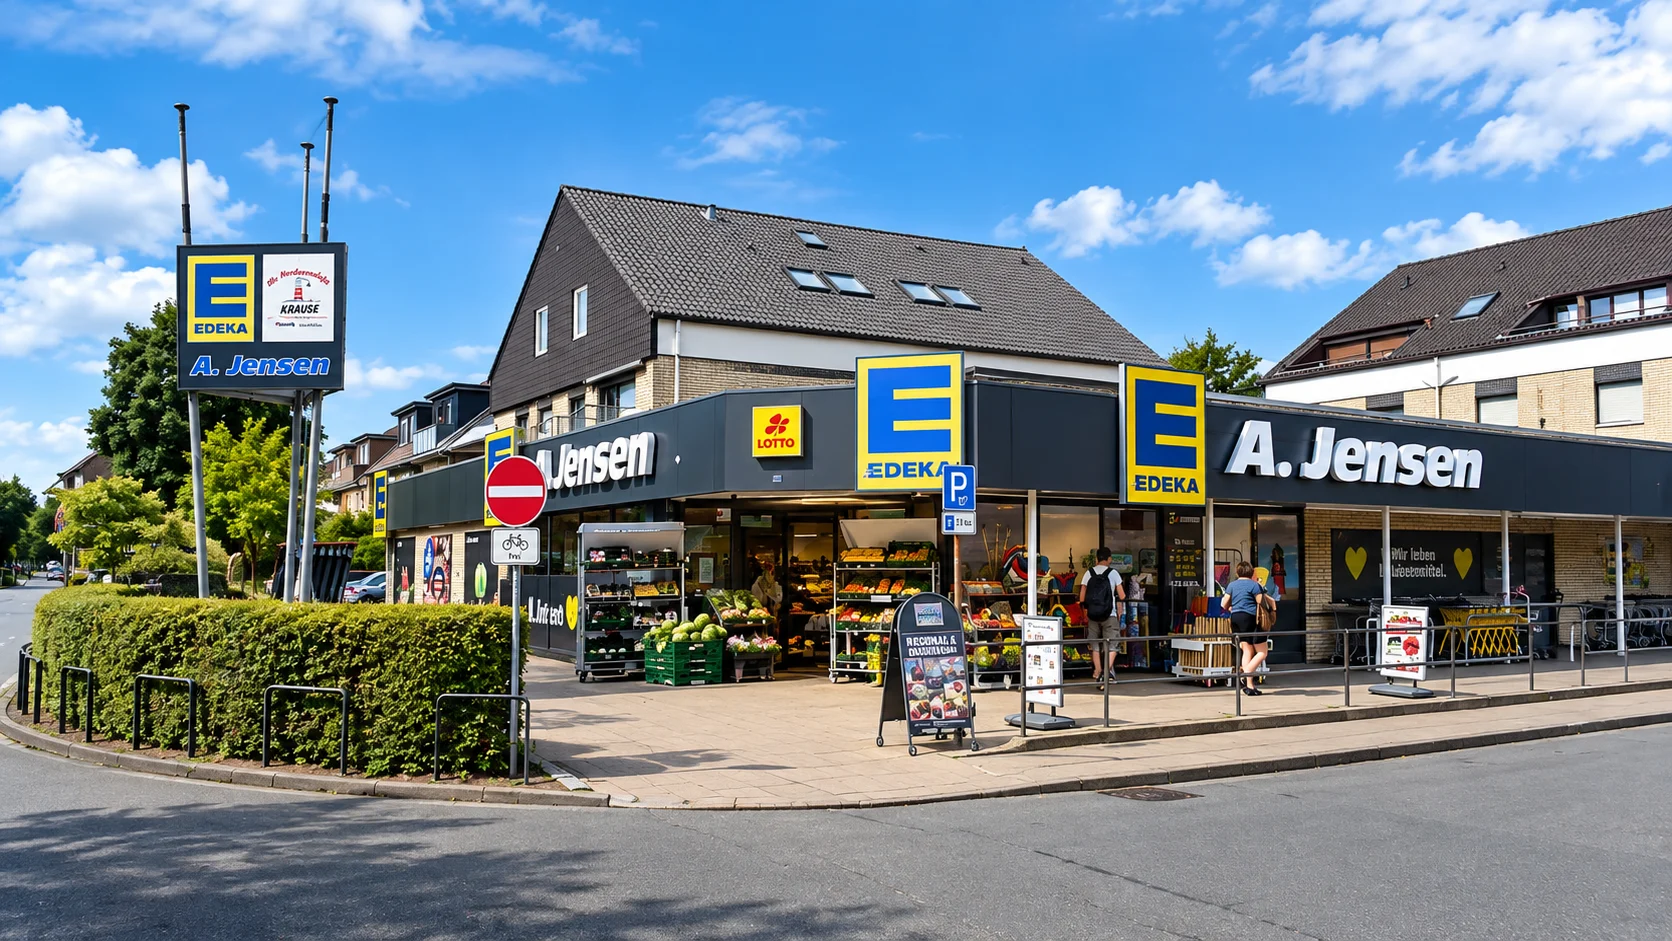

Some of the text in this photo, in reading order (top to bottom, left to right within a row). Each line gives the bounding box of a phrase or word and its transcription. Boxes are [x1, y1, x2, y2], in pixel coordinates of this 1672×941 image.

[195, 263, 247, 318] E
[280, 304, 320, 315] KRAUSE
[194, 323, 248, 334] EDEKA
[189, 355, 331, 377] A. Jensen
[868, 365, 951, 454] E
[1135, 378, 1197, 470] E
[757, 438, 795, 449] LOTTO
[1224, 420, 1483, 489] A. Jensen
[553, 431, 656, 490] Jensen
[950, 471, 968, 502] P
[1134, 474, 1200, 494] EDEKA
